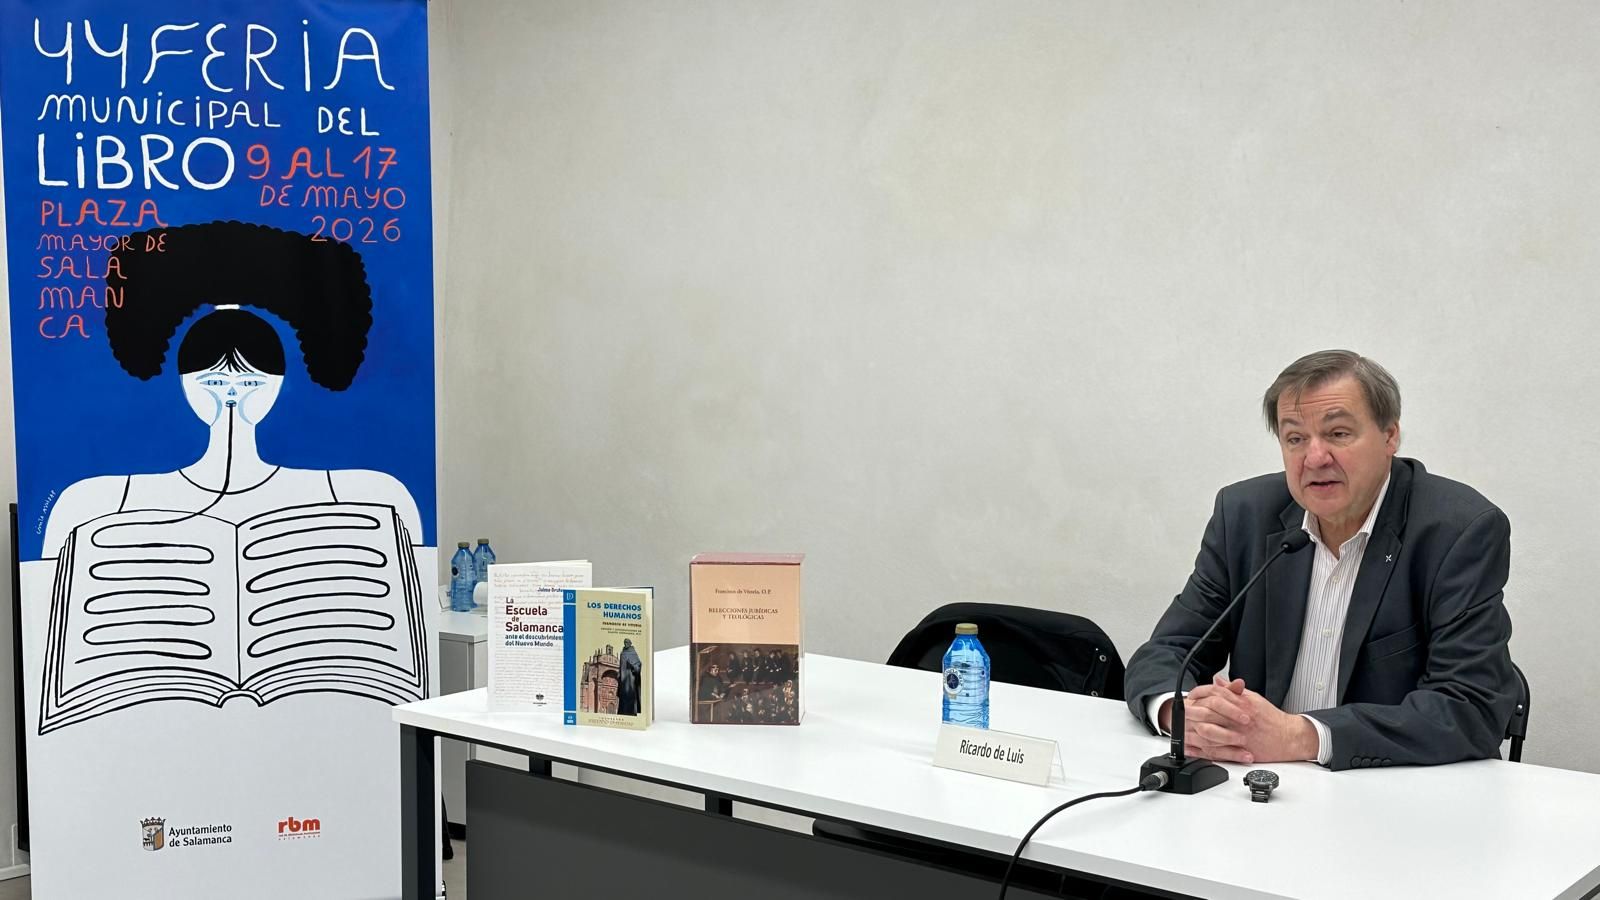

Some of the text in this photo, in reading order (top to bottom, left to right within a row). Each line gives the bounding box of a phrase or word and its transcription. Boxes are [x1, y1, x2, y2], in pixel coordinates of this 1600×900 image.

[317, 106, 380, 136] DEL
[246, 144, 399, 180] 9 AL 17
[260, 185, 406, 209] DE MAYO
[41, 199, 169, 227] PLAZA
[310, 216, 401, 243] 2026
[36, 233, 168, 252] MAYOR DE
[37, 256, 128, 279] SALA
[38, 286, 124, 309] MAN
[39, 315, 90, 338] CA
[505, 605, 548, 616] Escuela
[603, 611, 642, 620] HUMANOS
[604, 602, 642, 611] DERECHOS
[505, 621, 564, 633] Salamanca
[959, 739, 1025, 764] Ricardo de Luis
[168, 823, 233, 838] Ayuntamiento
[278, 816, 321, 833] rbm
[169, 834, 233, 848] de Salamanca
